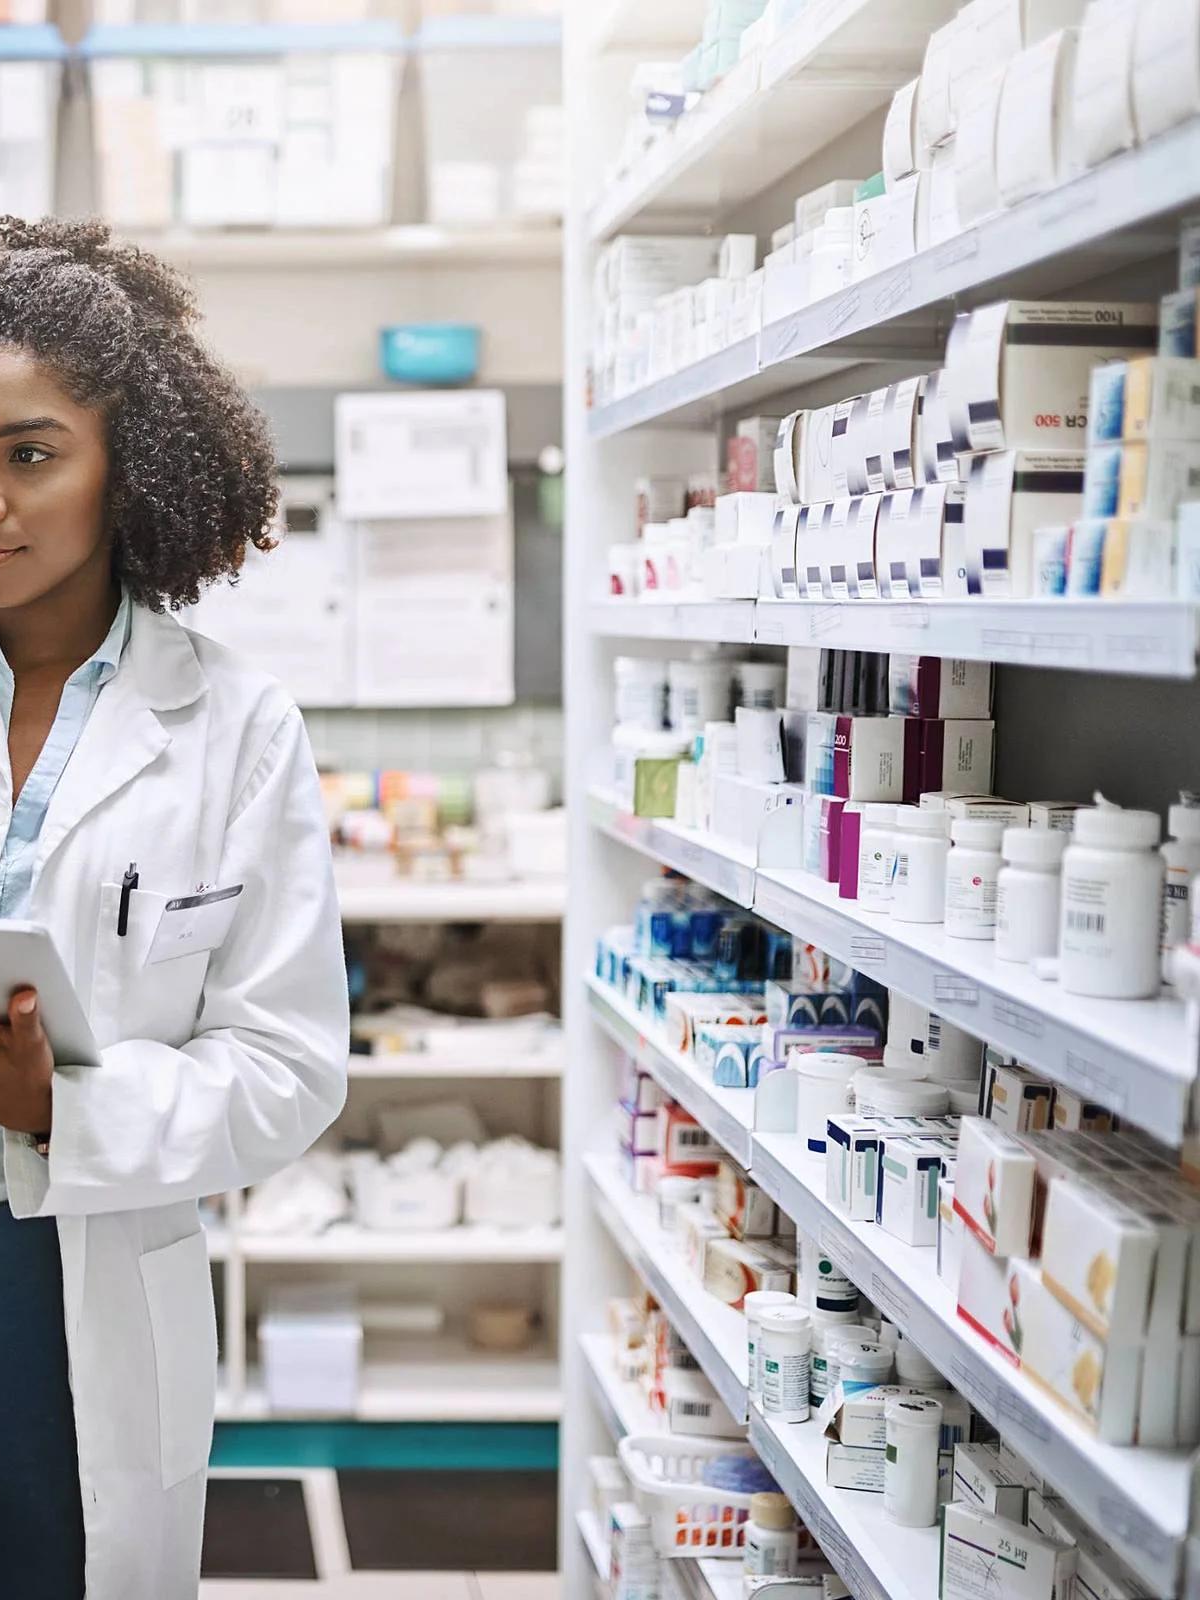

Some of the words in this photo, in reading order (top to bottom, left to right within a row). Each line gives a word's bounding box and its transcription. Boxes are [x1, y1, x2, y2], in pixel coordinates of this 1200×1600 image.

[1034, 414, 1061, 428] 500
[834, 734, 847, 746] 200
[997, 1538, 1012, 1553] 25
